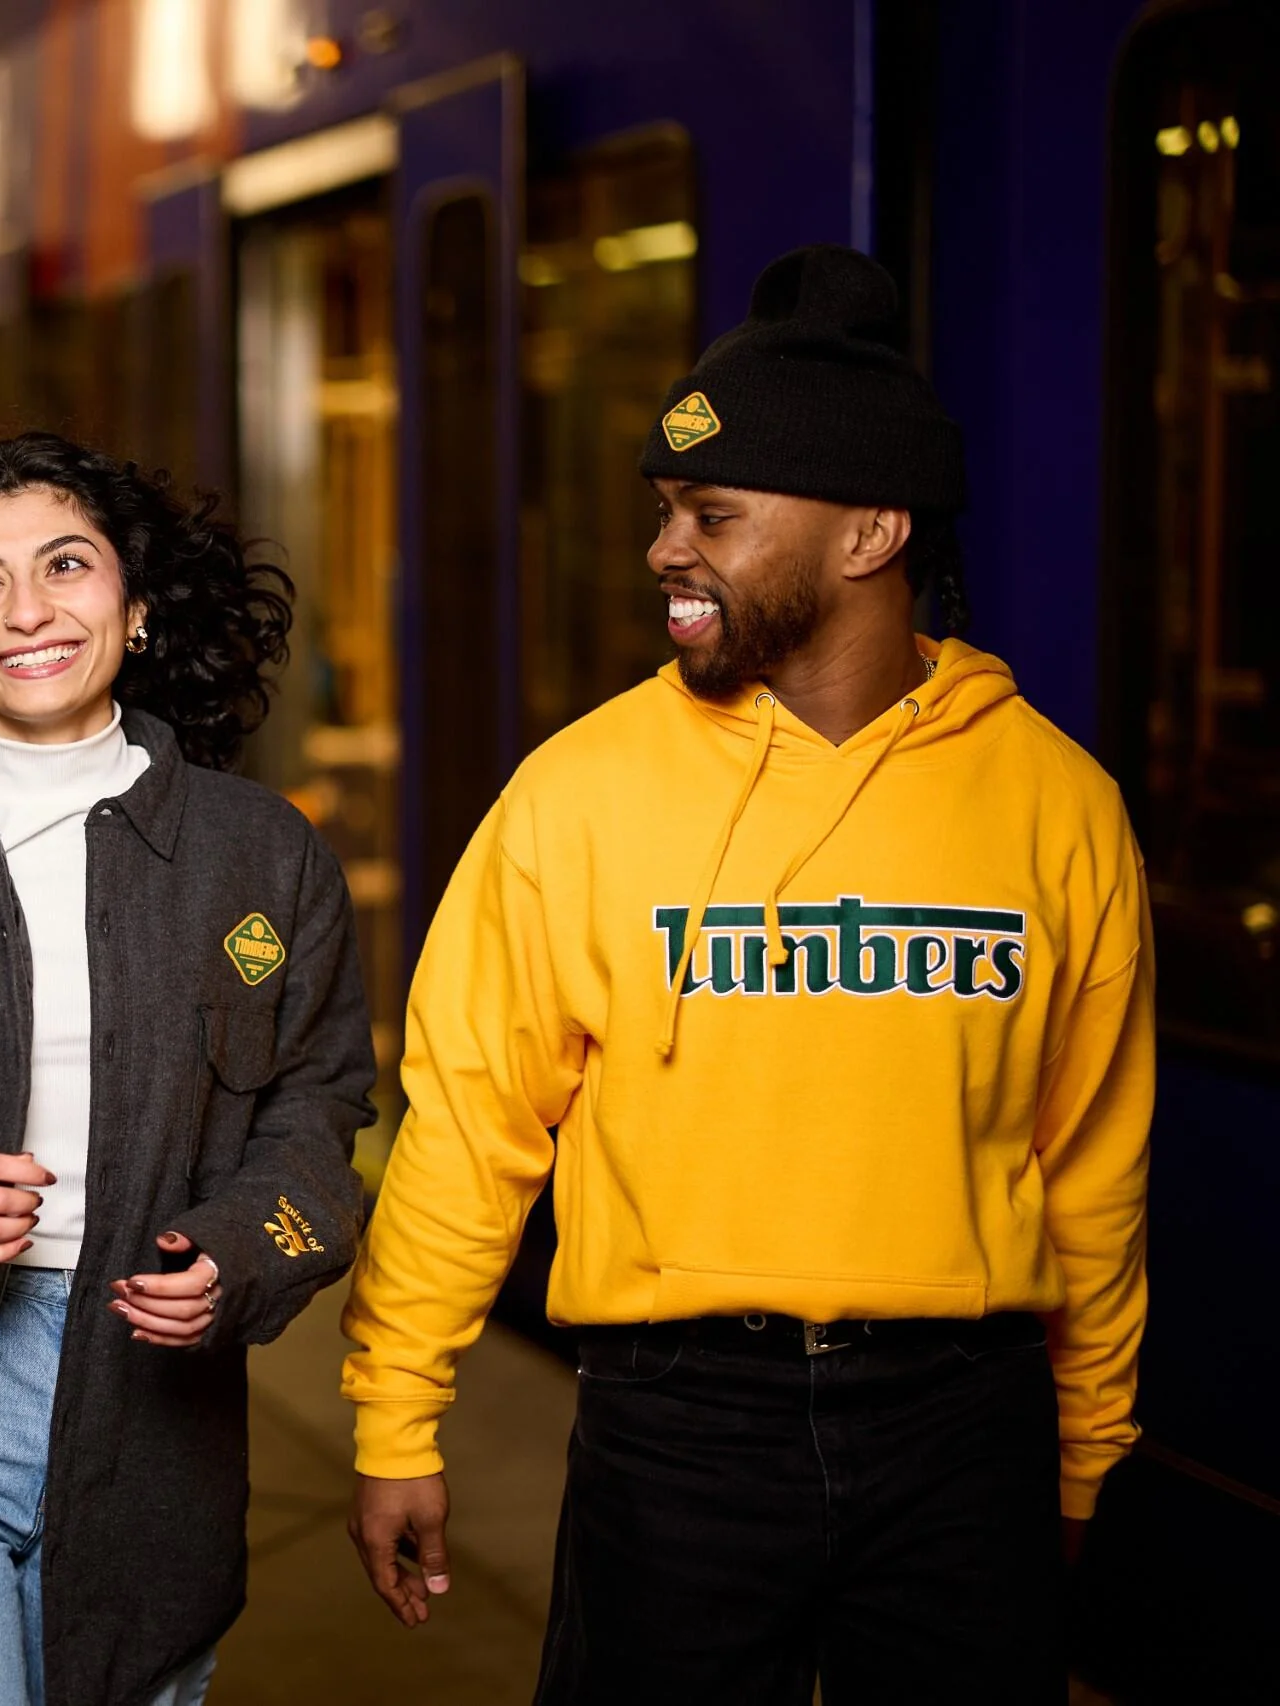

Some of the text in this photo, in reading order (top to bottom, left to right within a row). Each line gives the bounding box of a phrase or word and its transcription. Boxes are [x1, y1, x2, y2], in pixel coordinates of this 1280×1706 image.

[235, 936, 279, 961] TIMBERS
[653, 896, 1025, 1002] Timbers
[307, 1237, 325, 1253] of
